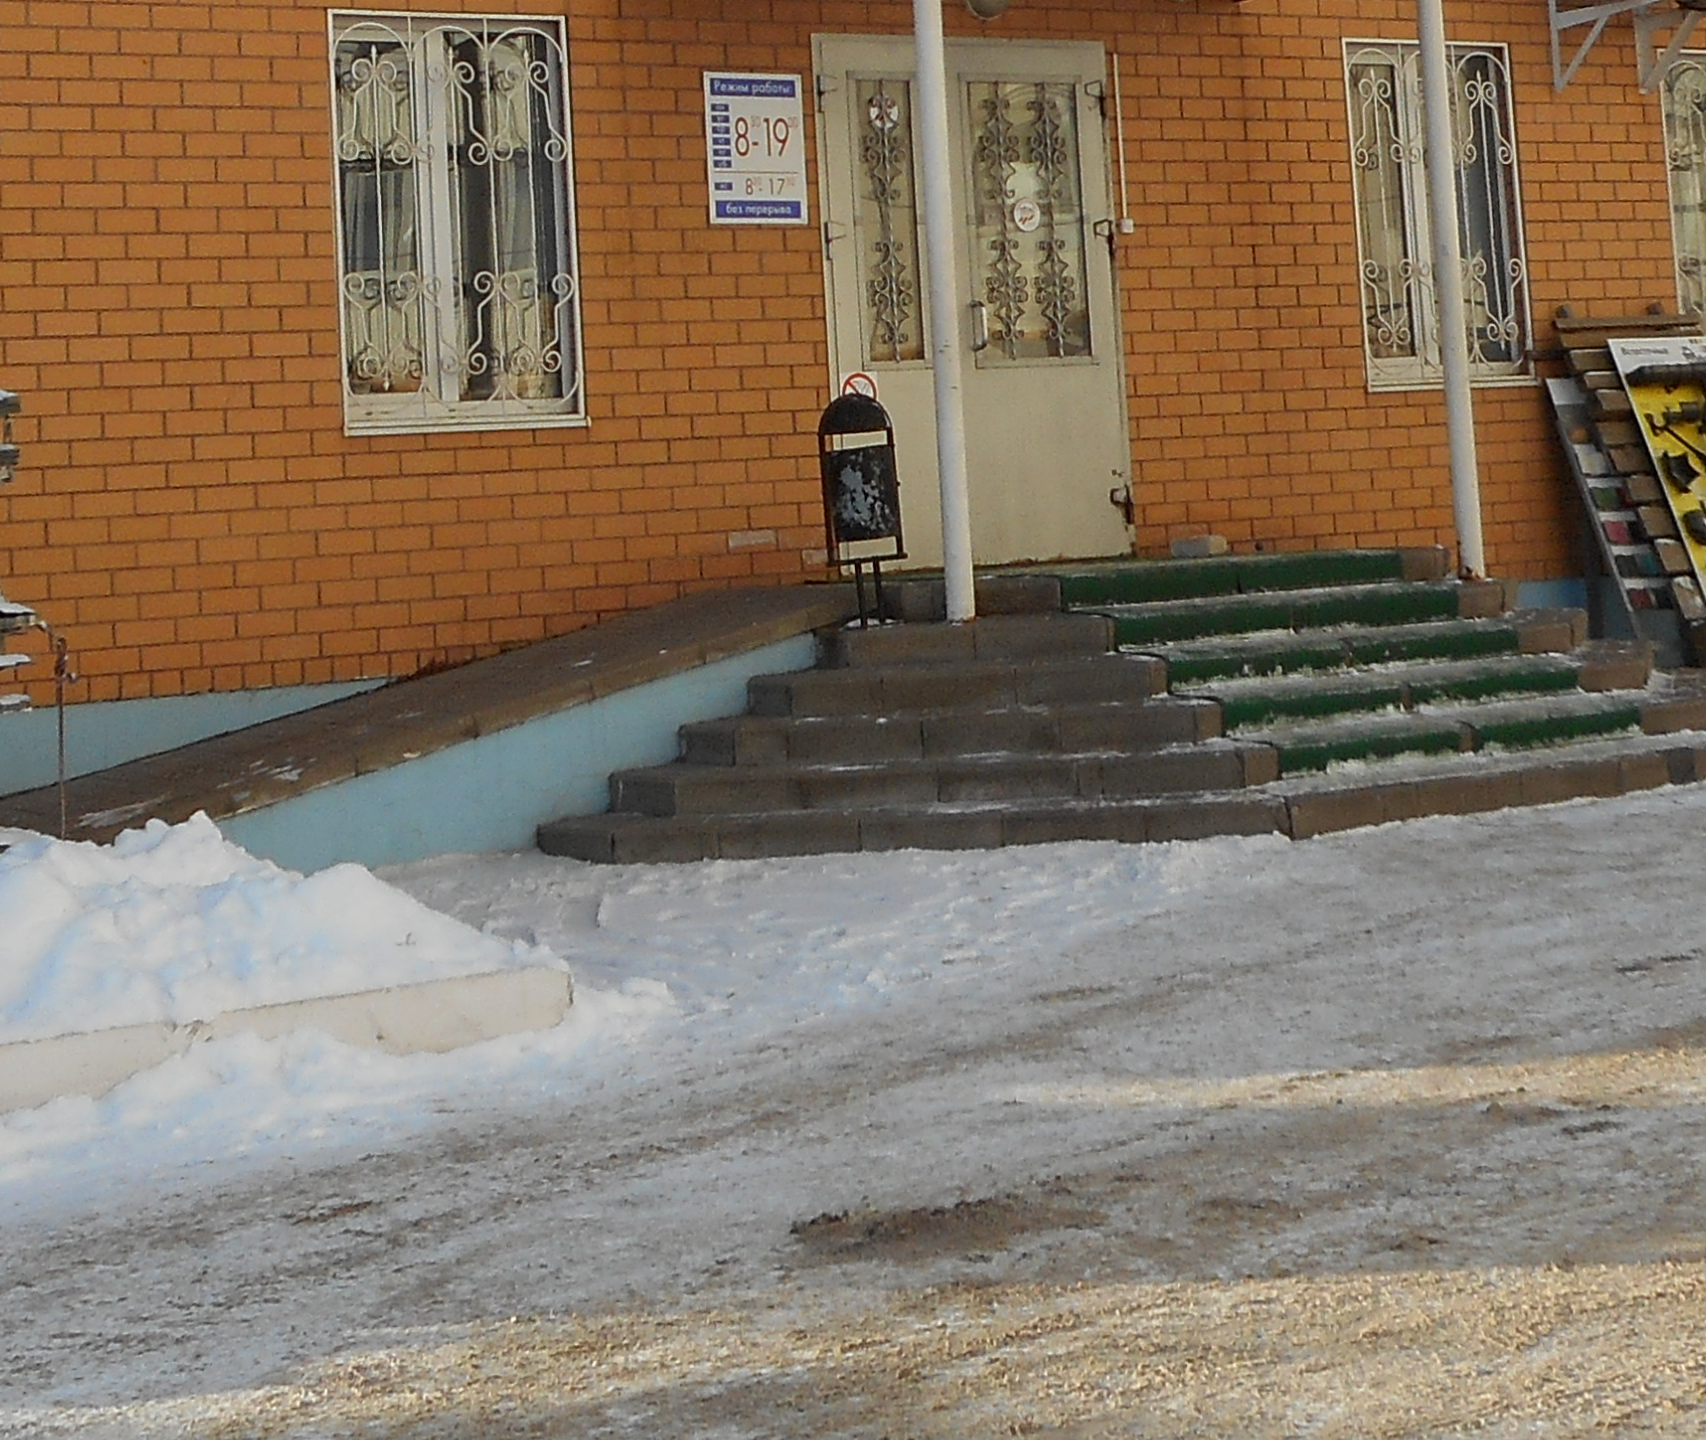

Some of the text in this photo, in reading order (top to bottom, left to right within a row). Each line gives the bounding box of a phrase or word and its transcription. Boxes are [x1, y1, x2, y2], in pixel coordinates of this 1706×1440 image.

[713, 80, 791, 95] Режим работы
[725, 202, 792, 217] без перерыва
